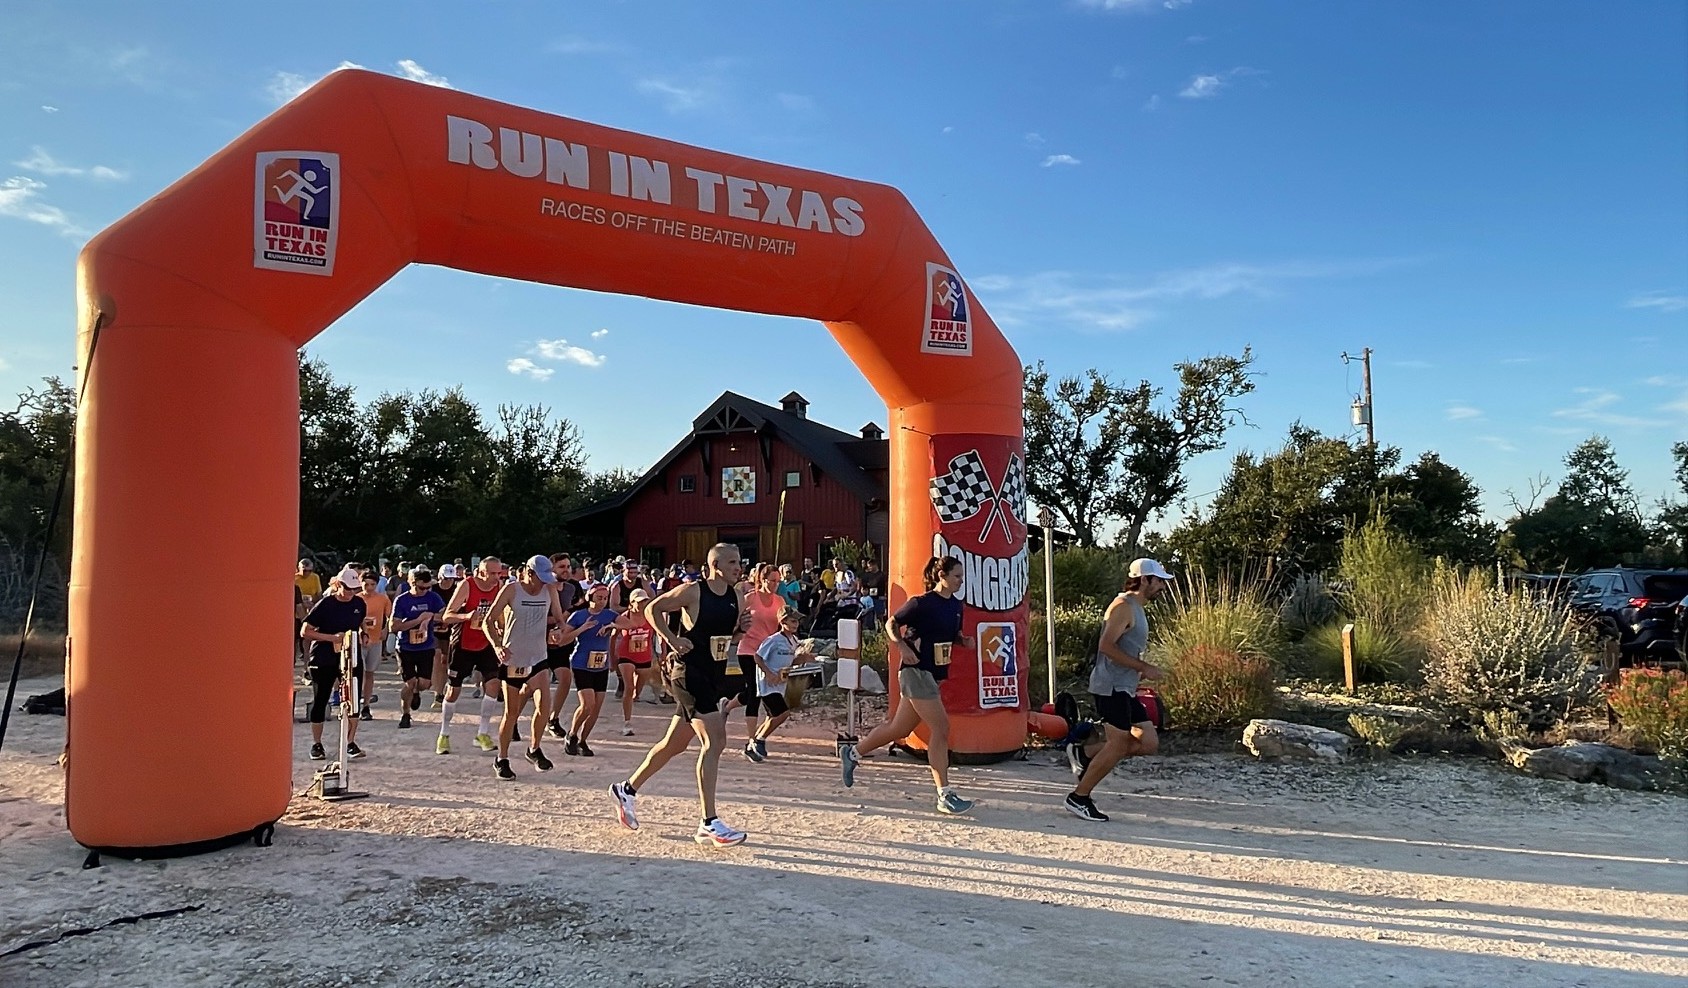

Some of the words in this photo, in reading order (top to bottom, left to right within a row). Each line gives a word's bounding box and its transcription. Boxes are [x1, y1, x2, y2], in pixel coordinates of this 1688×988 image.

[446, 114, 590, 191] RUN
[608, 151, 672, 205] IN
[685, 166, 866, 237] TEXAS
[541, 198, 606, 225] RACES
[611, 211, 648, 231] OFF
[652, 218, 687, 238] THE
[690, 225, 754, 249] BEATEN
[758, 237, 796, 255] PATH
[265, 223, 304, 240] RUN
[309, 229, 328, 243] IN
[265, 237, 326, 256] TEXAS
[267, 253, 324, 265] RUNINTEXAS.COM
[931, 321, 953, 331] RUN
[957, 323, 966, 332] IN
[930, 331, 967, 342] TEXAS
[734, 479, 743, 492] R
[983, 677, 1005, 687] RUN
[983, 687, 1017, 697] TEXAS
